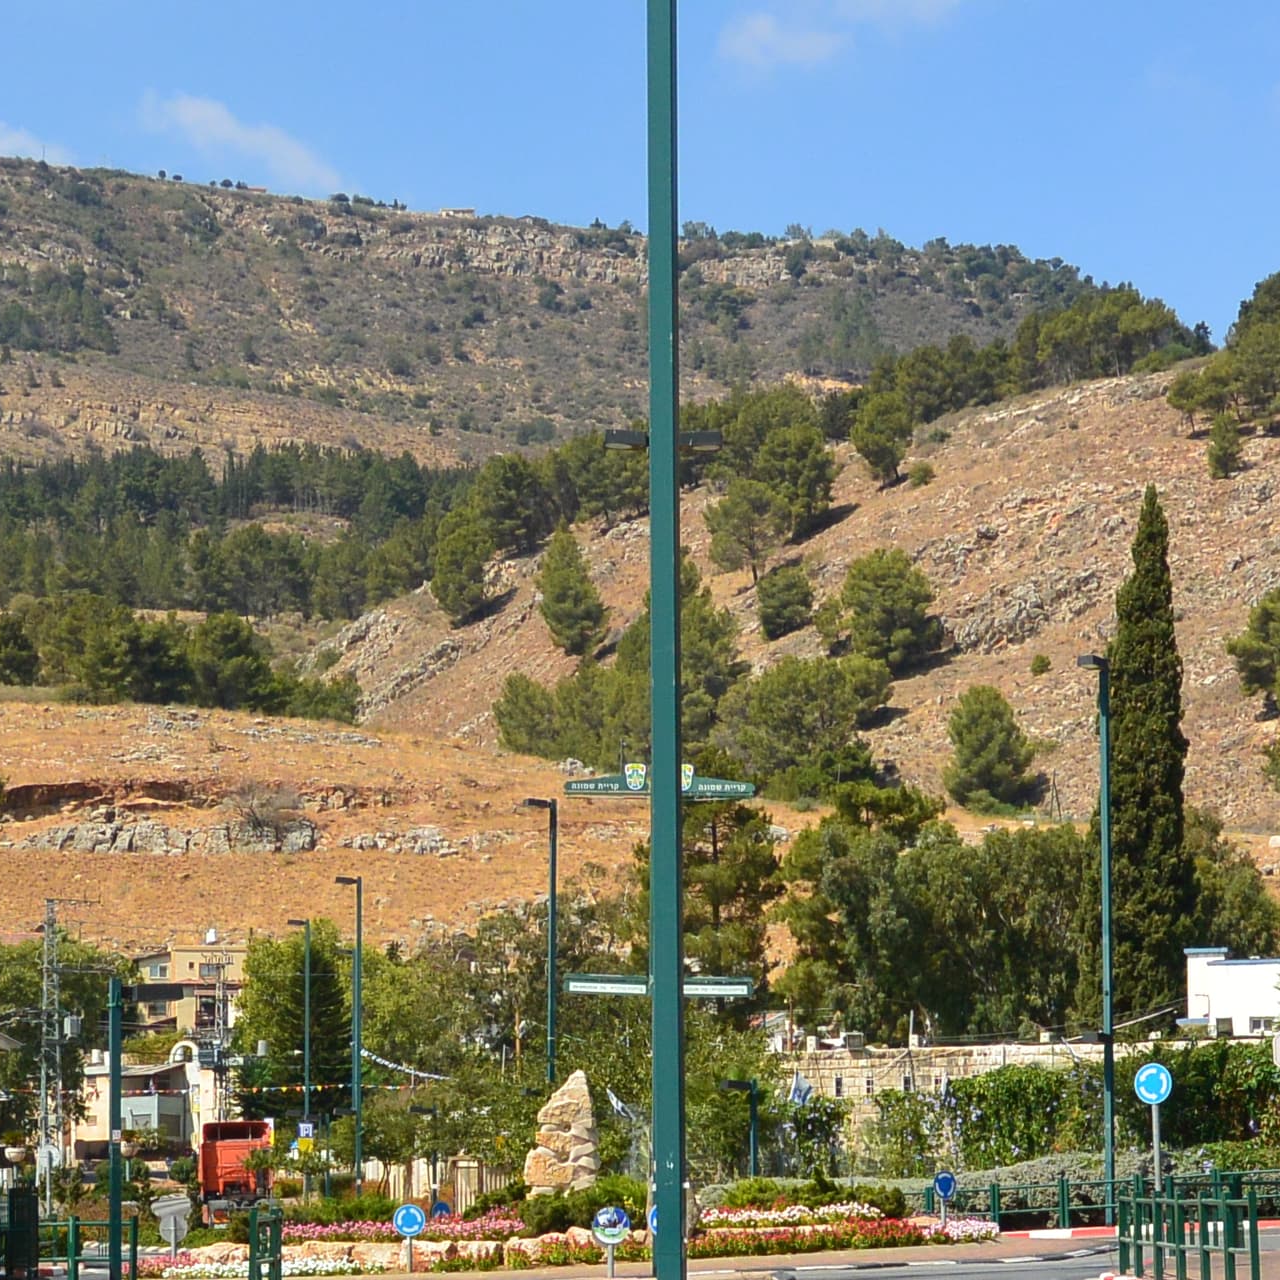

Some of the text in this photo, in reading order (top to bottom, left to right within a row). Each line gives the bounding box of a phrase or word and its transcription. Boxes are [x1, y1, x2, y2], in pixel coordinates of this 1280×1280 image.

[572, 782, 620, 791] קריית שמונה
[722, 784, 747, 792] קריית
